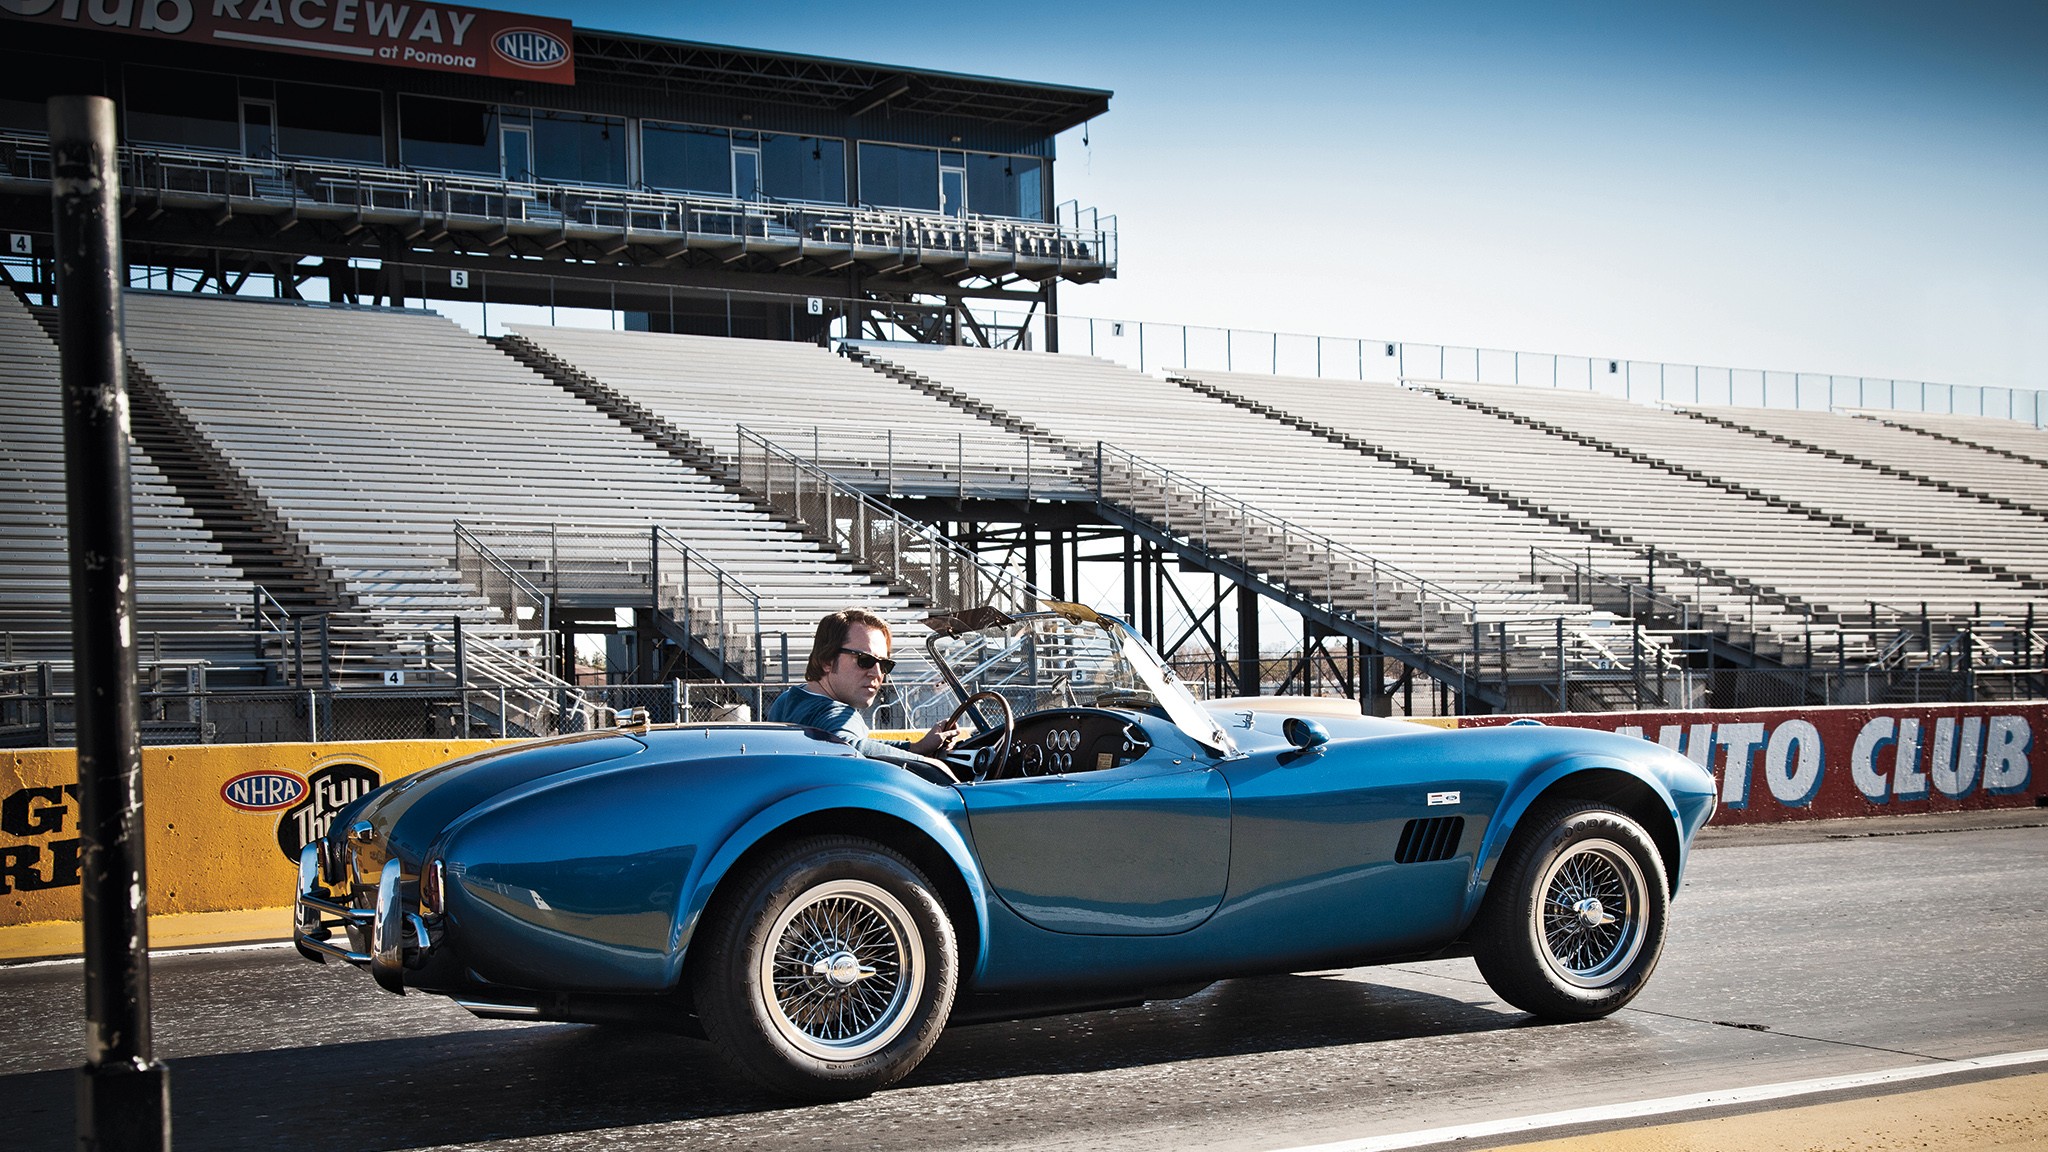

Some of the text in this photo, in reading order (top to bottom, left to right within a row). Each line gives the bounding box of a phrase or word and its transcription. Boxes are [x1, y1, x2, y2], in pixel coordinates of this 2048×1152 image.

[0, 0, 476, 46] ub RACEWAY
[503, 33, 561, 62] NHRA
[379, 45, 477, 68] at Pomona
[16, 236, 26, 251] 4
[455, 272, 464, 286] 5
[811, 300, 820, 312] 6
[1114, 324, 1122, 335] 7
[1387, 344, 1394, 356] 8
[1610, 362, 1618, 373] 9
[389, 672, 399, 684] 4
[1075, 670, 1084, 680] 5
[1615, 716, 2033, 803] TO CLUB
[233, 776, 297, 804] NHRA
[315, 774, 370, 816] Full
